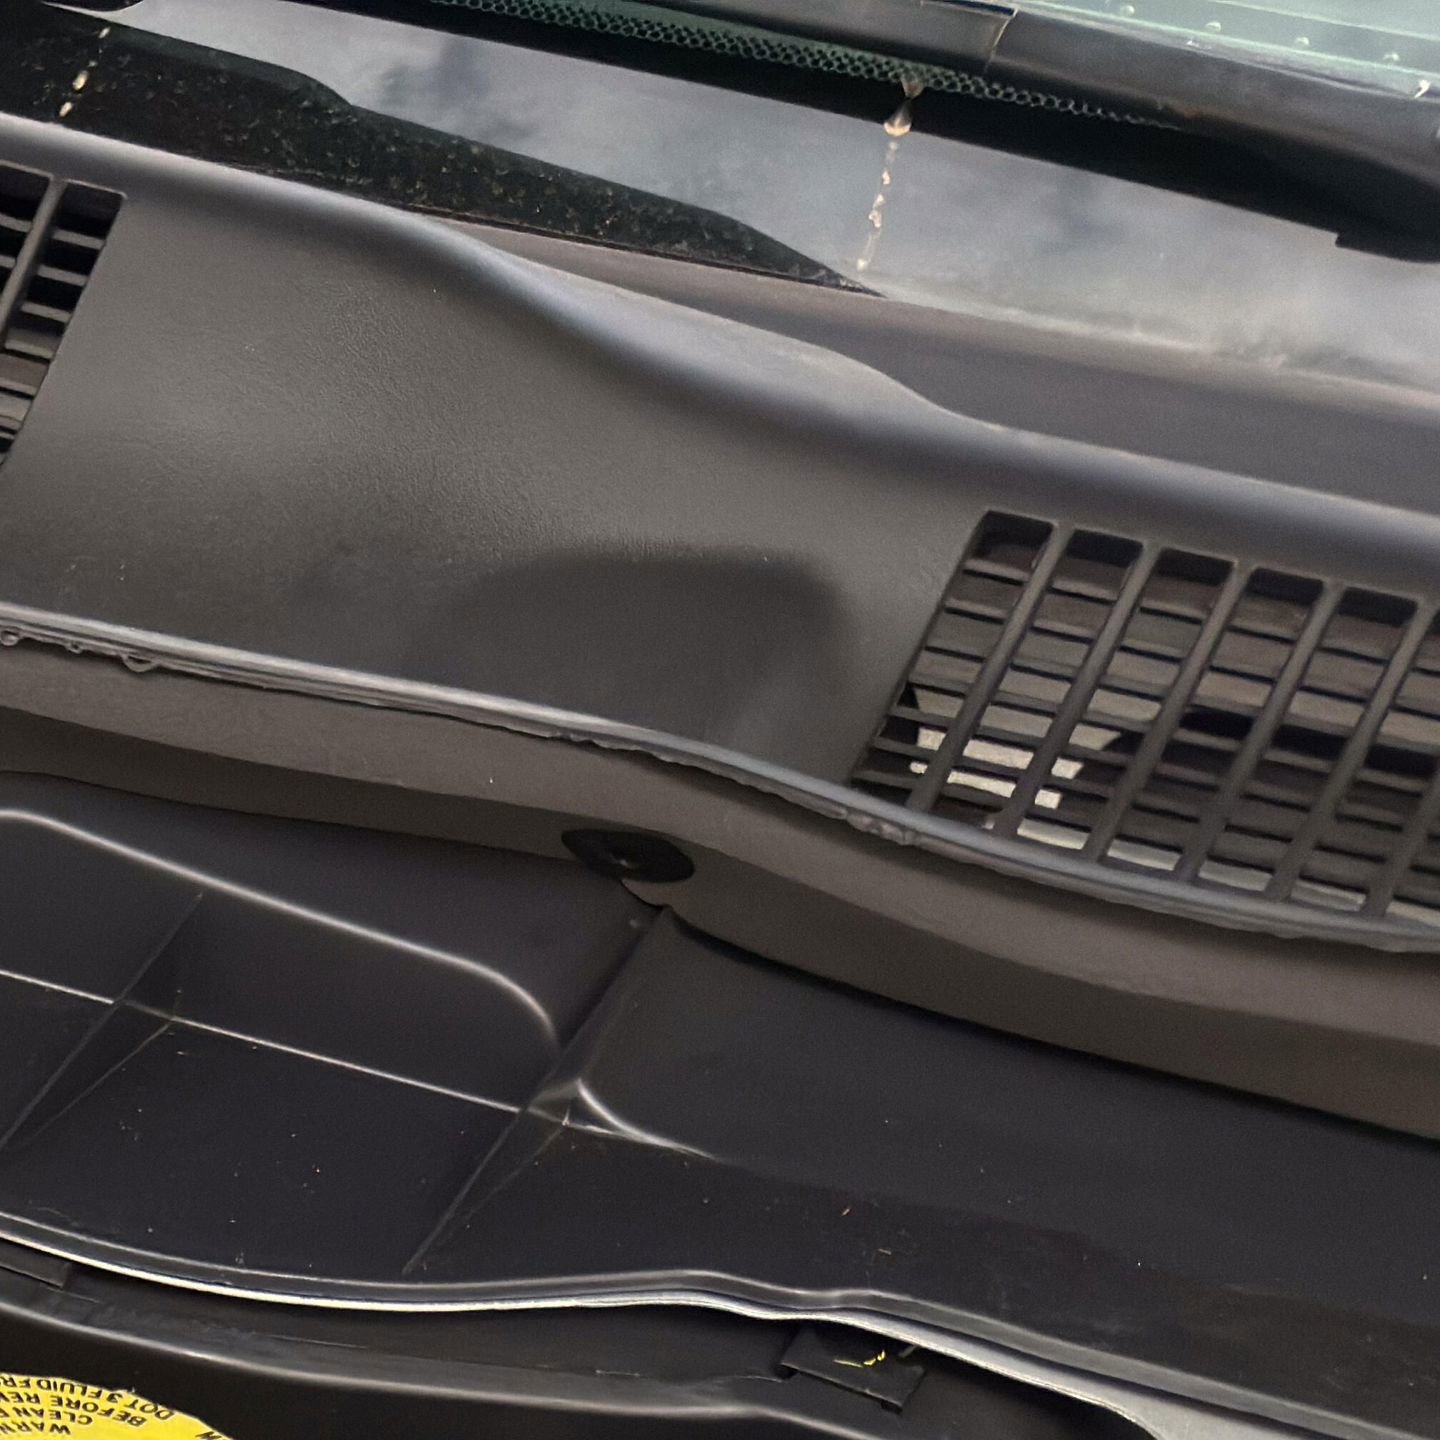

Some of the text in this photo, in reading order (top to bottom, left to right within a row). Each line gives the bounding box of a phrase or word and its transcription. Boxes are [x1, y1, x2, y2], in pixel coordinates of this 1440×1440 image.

[36, 1377, 103, 1399] FLUID
[106, 1393, 123, 1402] 3
[14, 1407, 93, 1426] CLEAN
[50, 1394, 147, 1428] BEFORE
[126, 1399, 175, 1420] DOT
